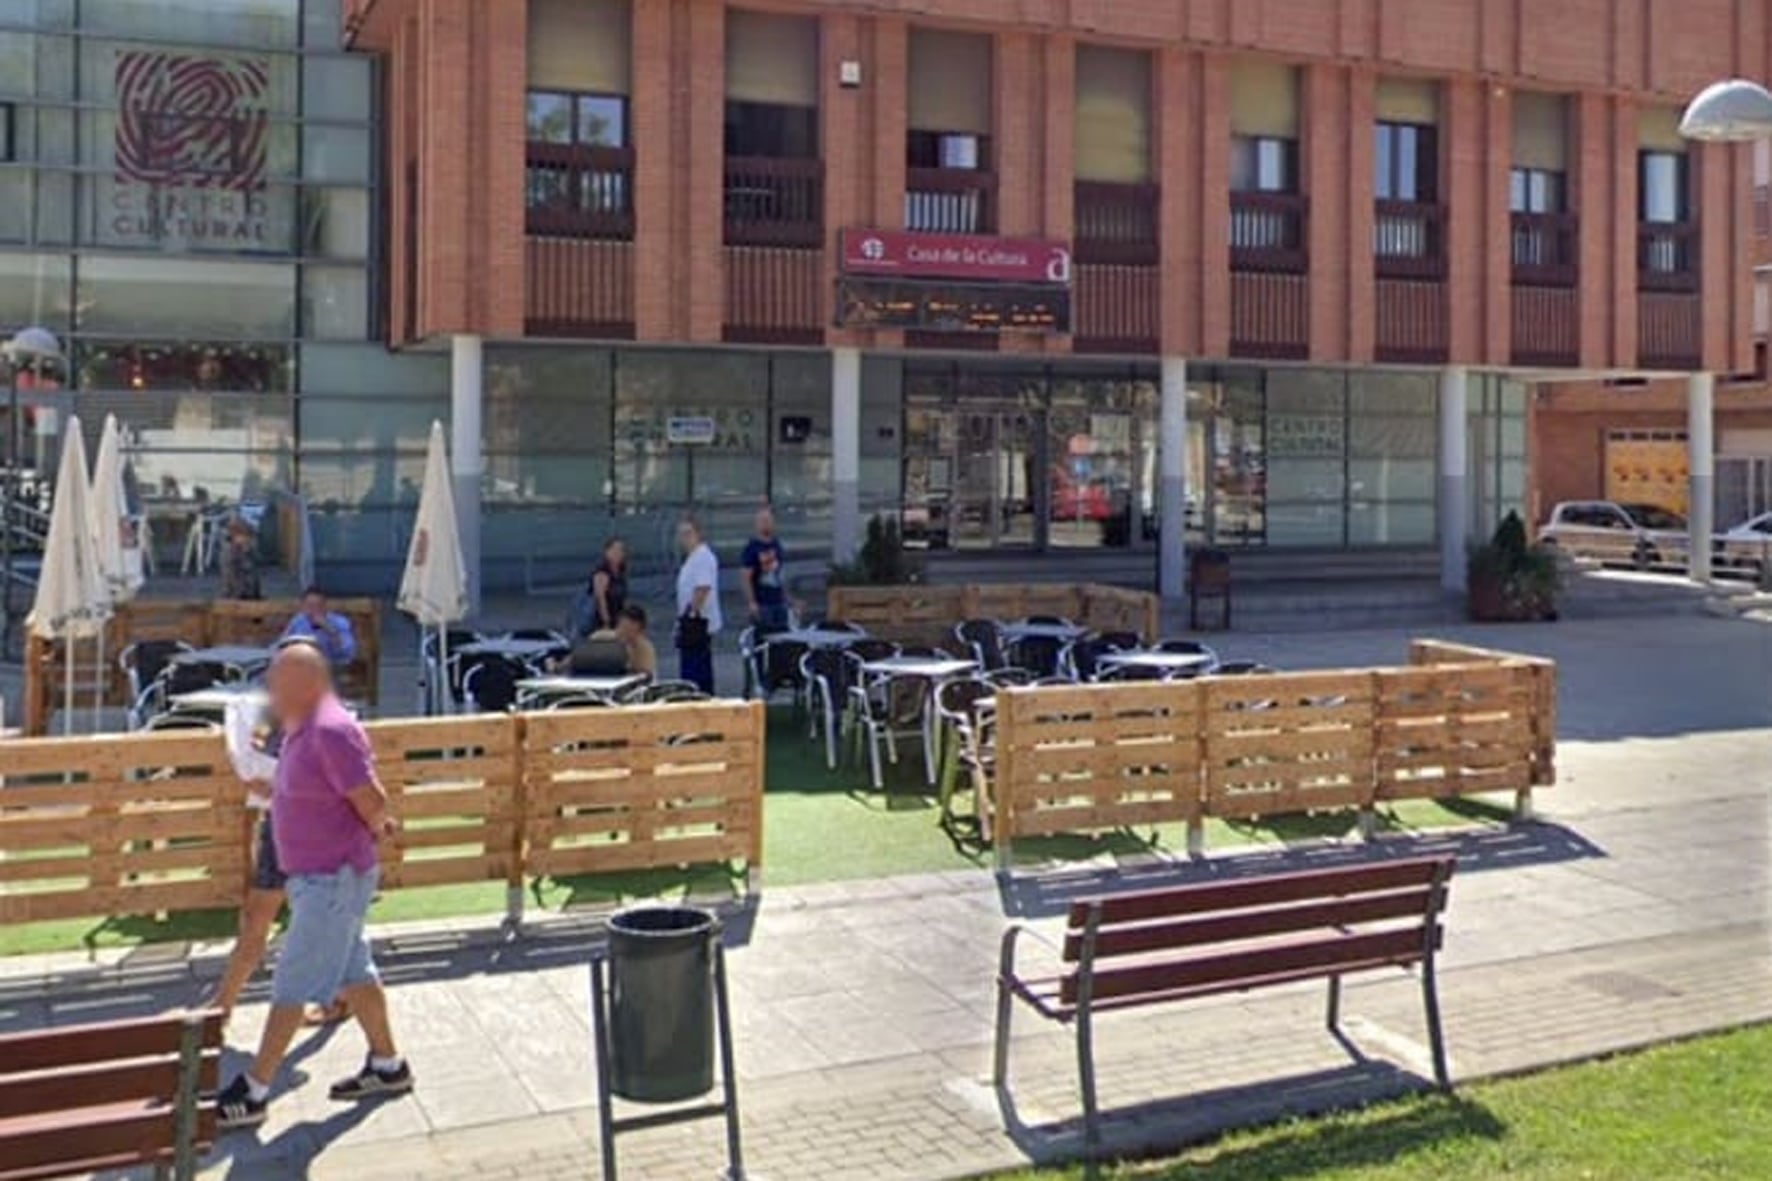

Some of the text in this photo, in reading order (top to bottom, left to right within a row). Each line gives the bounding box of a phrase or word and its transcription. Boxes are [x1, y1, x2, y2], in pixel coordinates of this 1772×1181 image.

[112, 215, 266, 240] CULTURAL
[906, 245, 1028, 265] Casa de la Cultura
[1270, 416, 1341, 435] CENTRO
